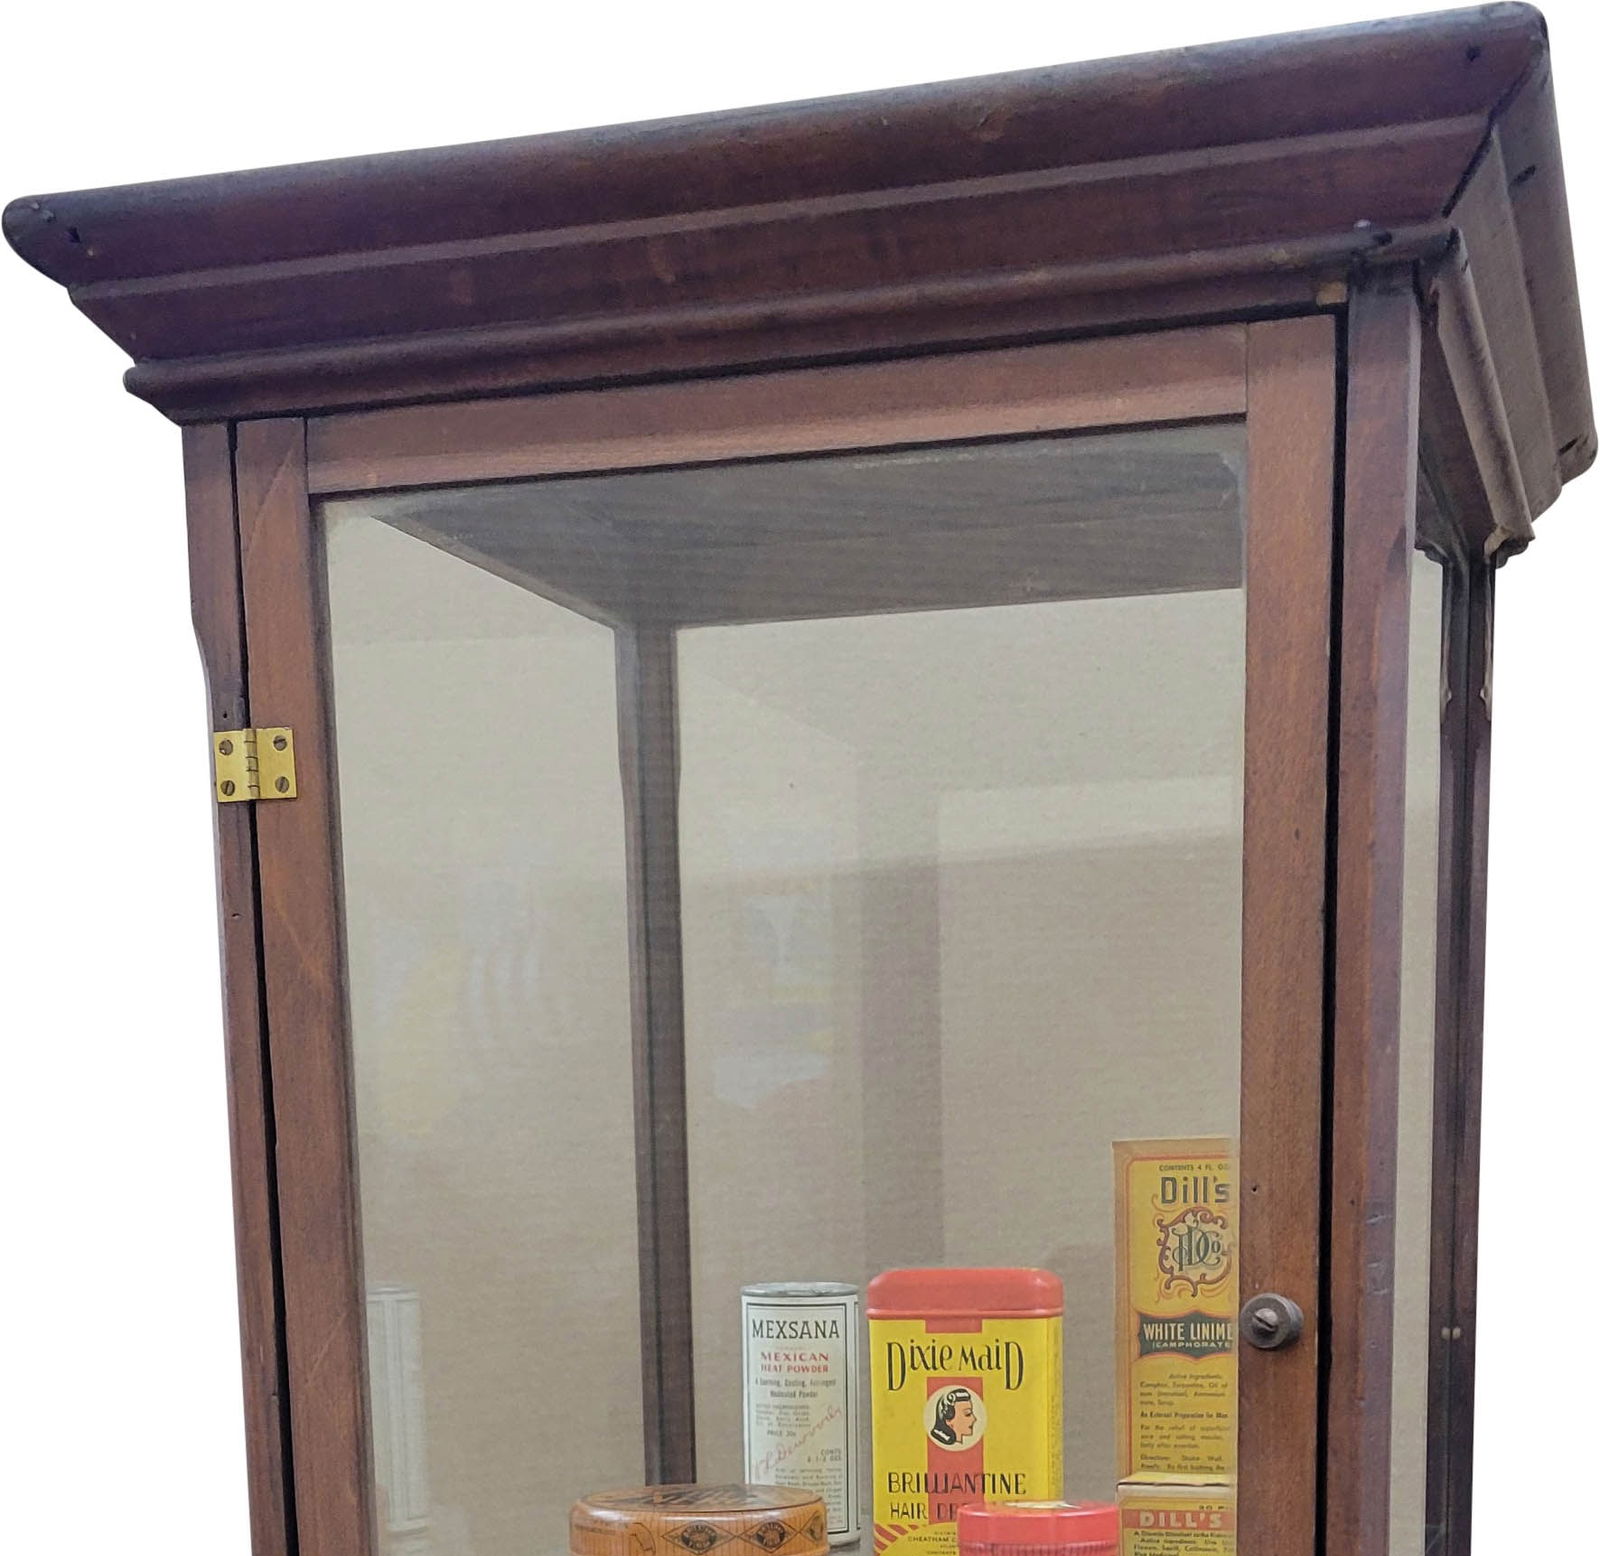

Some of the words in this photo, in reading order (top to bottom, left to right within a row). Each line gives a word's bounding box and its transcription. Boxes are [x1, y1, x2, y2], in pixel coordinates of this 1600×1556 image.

[1160, 1175, 1231, 1204] Dill's
[751, 1319, 840, 1339] MEXSANA
[1143, 1323, 1185, 1341] WHITE
[760, 1351, 830, 1362] MEXICAN
[886, 1339, 953, 1392] Dixie
[761, 1363, 783, 1373] HEAT
[786, 1364, 829, 1374] POWDER
[888, 1472, 1027, 1496] BRILLIANTINE
[890, 1502, 929, 1520] HAIR
[1139, 1511, 1222, 1529] DILL'S
